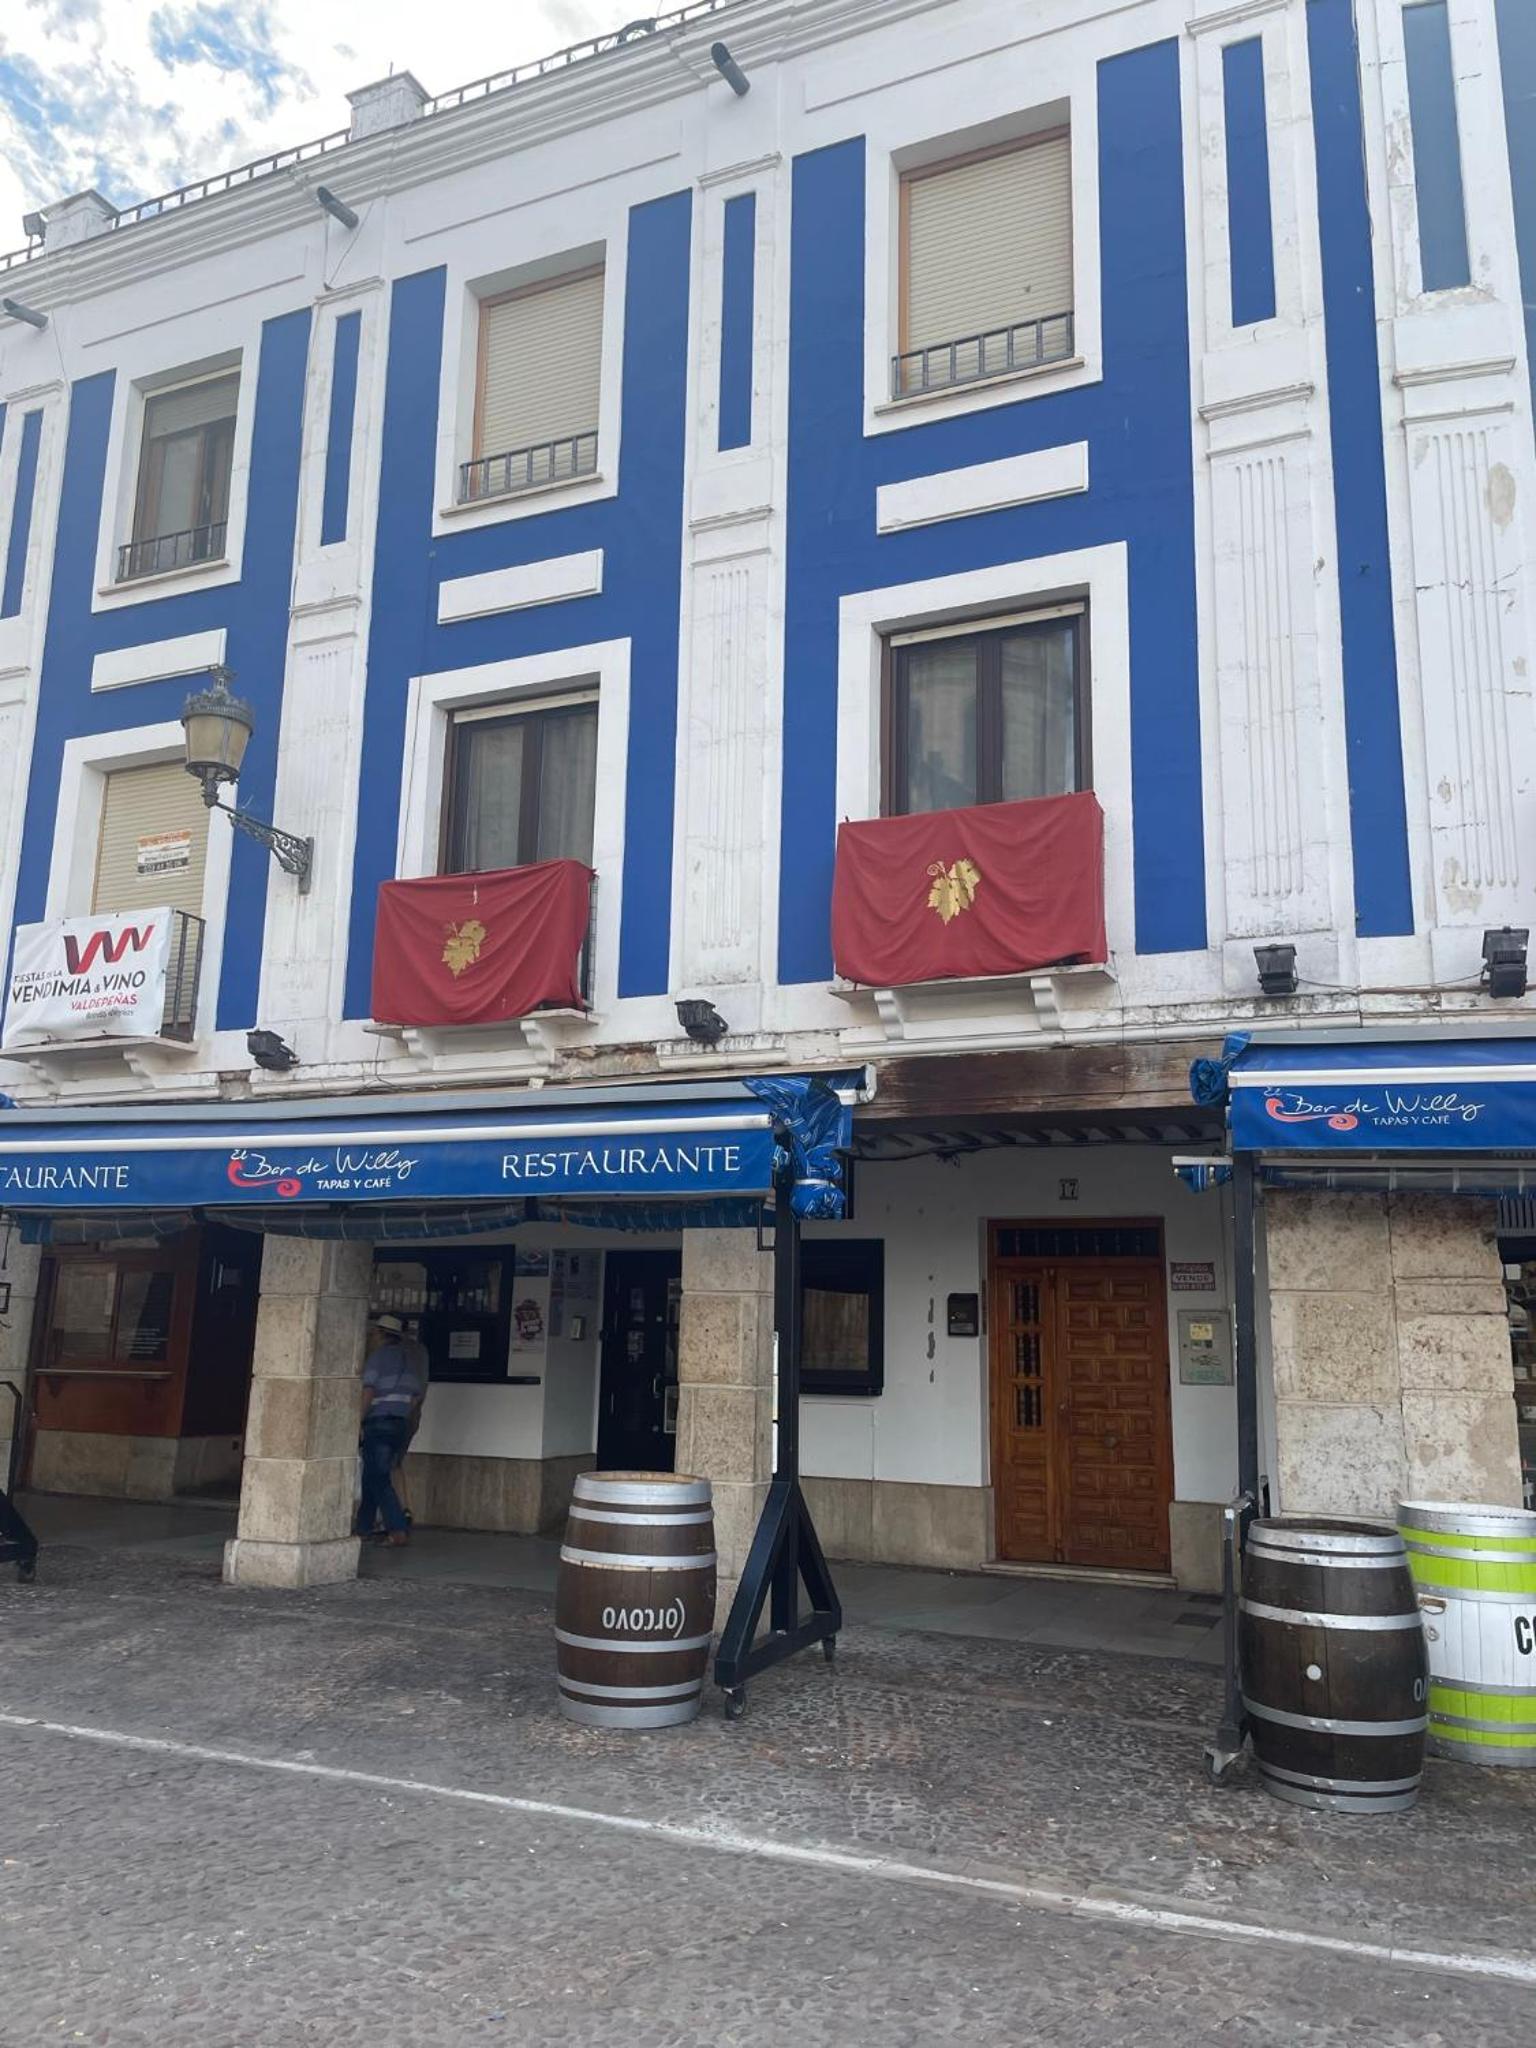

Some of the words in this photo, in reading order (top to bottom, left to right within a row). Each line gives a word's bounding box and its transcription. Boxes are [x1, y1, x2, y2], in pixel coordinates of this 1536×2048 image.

[14, 972, 45, 983] FIESTAS
[53, 970, 63, 978] LA
[13, 977, 91, 1004] VENDIMIA
[103, 970, 146, 991] VINO
[71, 993, 138, 1010] VALDEPEÑAS
[1282, 1093, 1338, 1115] Bar
[1343, 1098, 1379, 1113] de
[1385, 1089, 1486, 1121] Willy
[1371, 1116, 1409, 1126] TAPAS
[1411, 1116, 1419, 1125] Y
[243, 1153, 293, 1178] Bar
[296, 1157, 329, 1175] de
[336, 1147, 419, 1180] Willy
[502, 1146, 741, 1179] RESTAURANTE
[316, 1180, 350, 1190] TAPAS
[354, 1179, 362, 1189] Y
[364, 1175, 392, 1189] CAFÉ
[1060, 1180, 1078, 1199] 17
